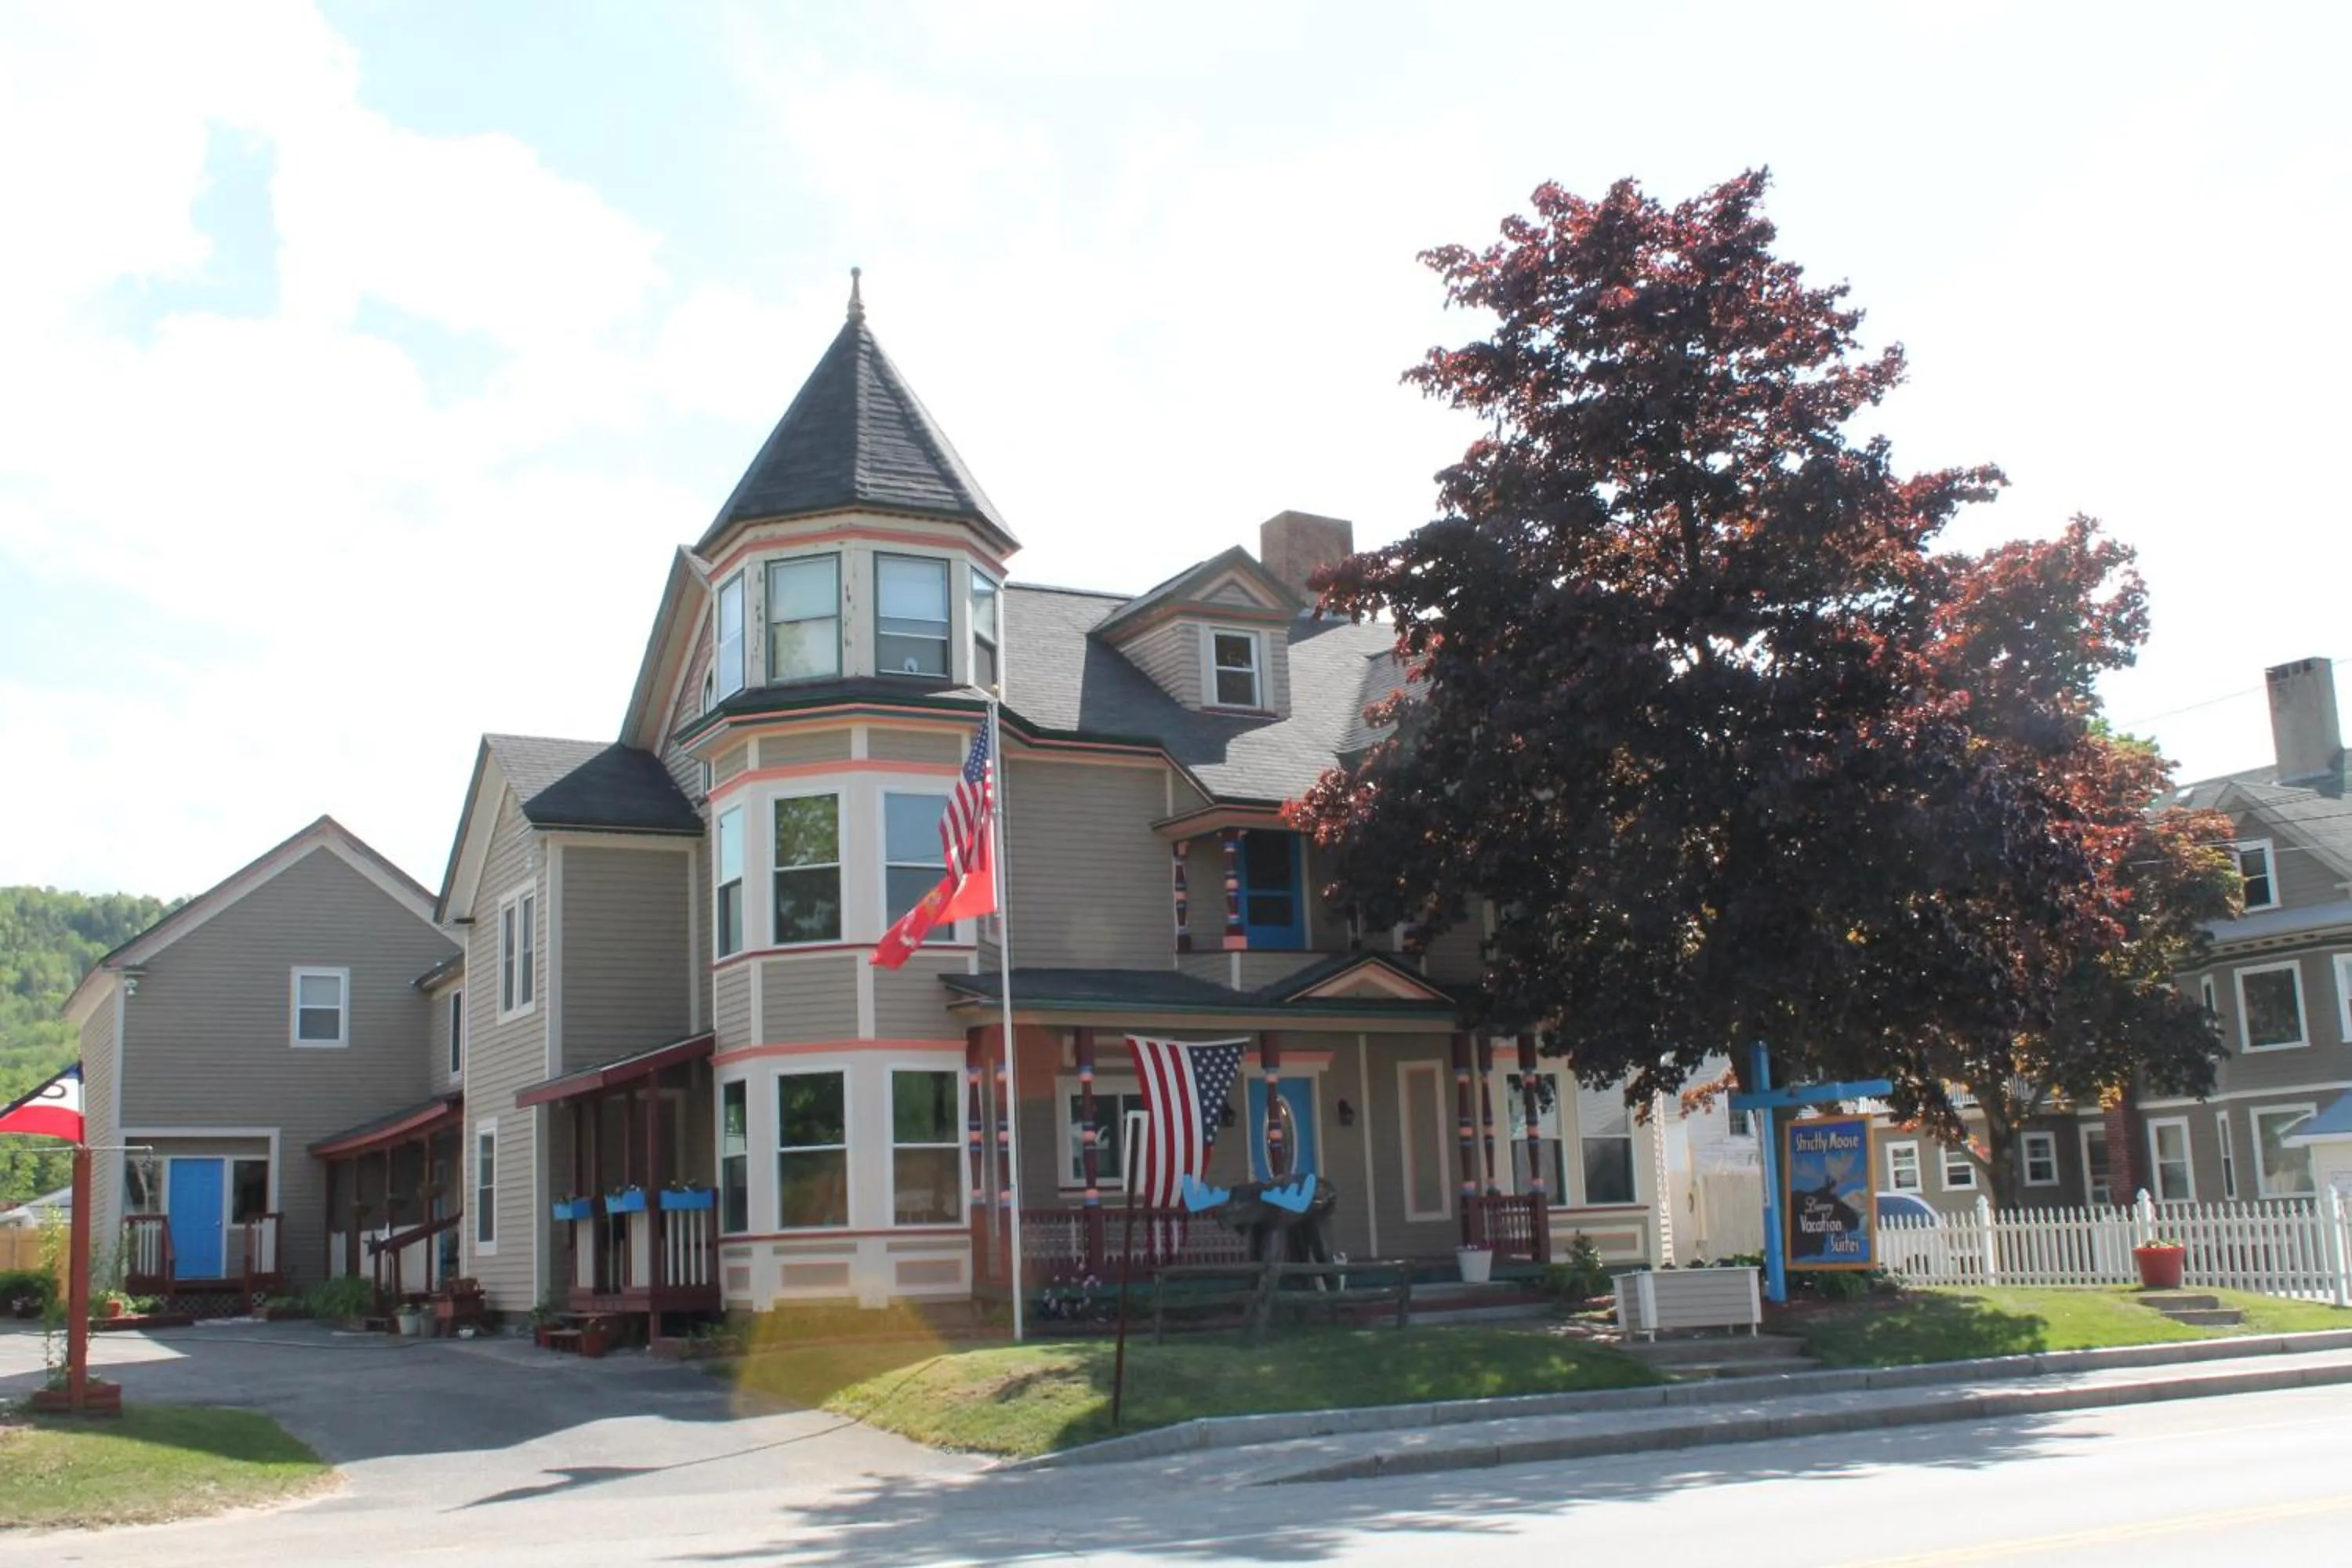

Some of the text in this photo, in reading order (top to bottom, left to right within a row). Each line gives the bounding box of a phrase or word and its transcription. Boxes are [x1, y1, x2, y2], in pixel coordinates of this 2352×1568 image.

[1796, 1133, 1828, 1155] Strictly
[1799, 1213, 1842, 1233] Vacation
[1831, 1233, 1860, 1253] Suites
